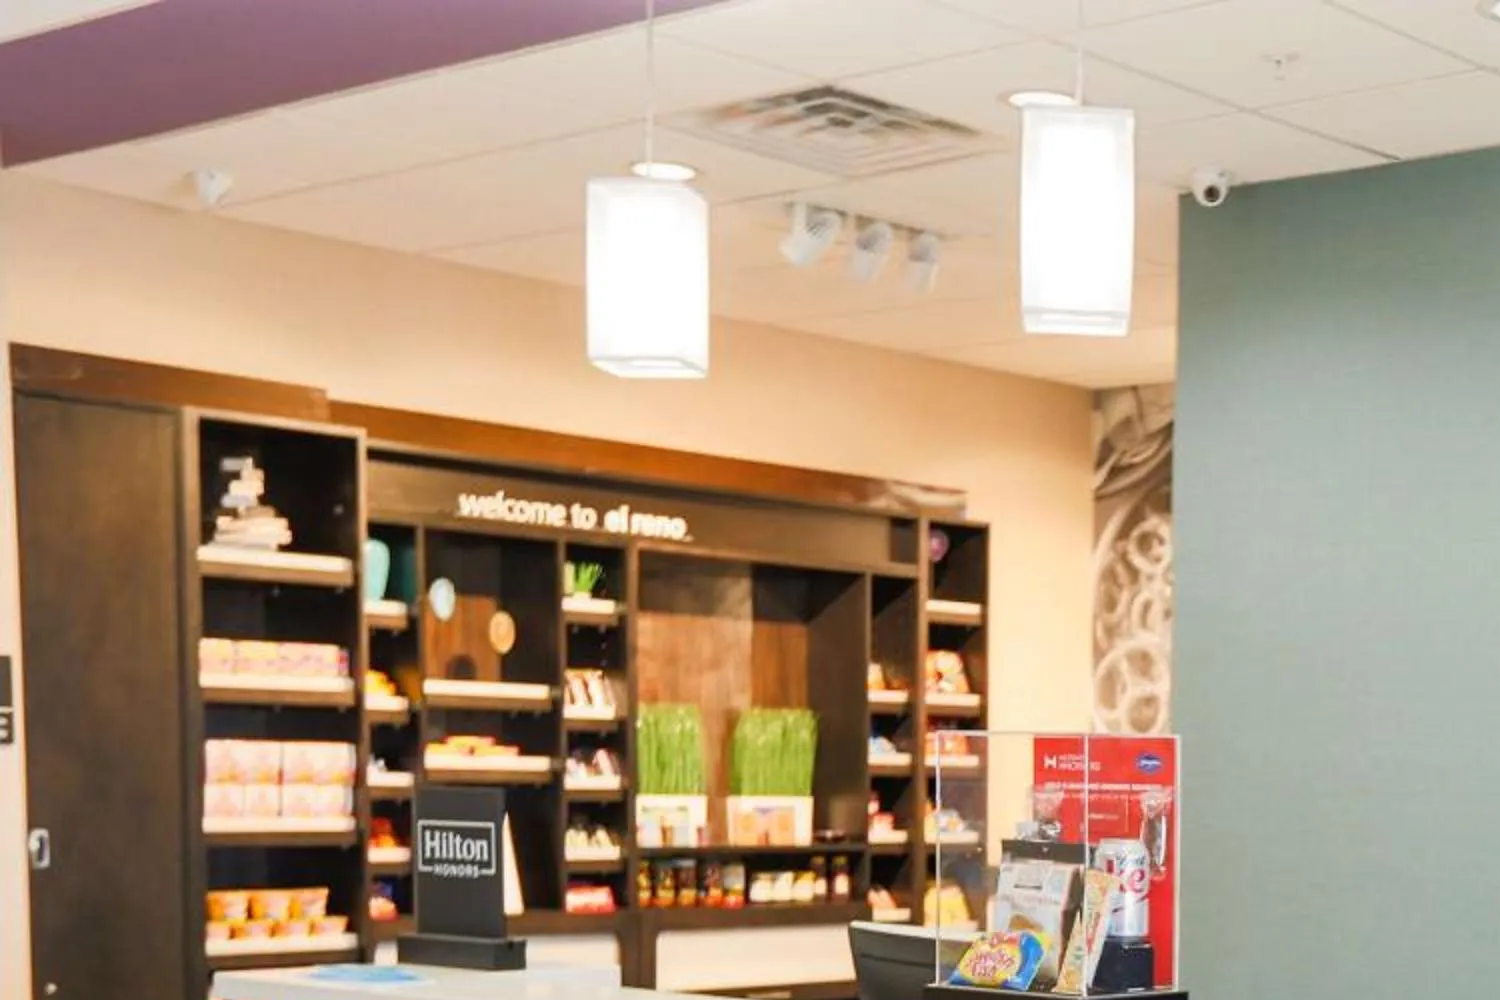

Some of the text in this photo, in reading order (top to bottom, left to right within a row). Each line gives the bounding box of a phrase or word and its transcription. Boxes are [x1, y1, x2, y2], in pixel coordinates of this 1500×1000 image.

[458, 489, 567, 528] welcome
[570, 503, 598, 530] to
[604, 504, 630, 534] el
[424, 829, 489, 862] Hilton
[433, 863, 479, 880] HONORS
